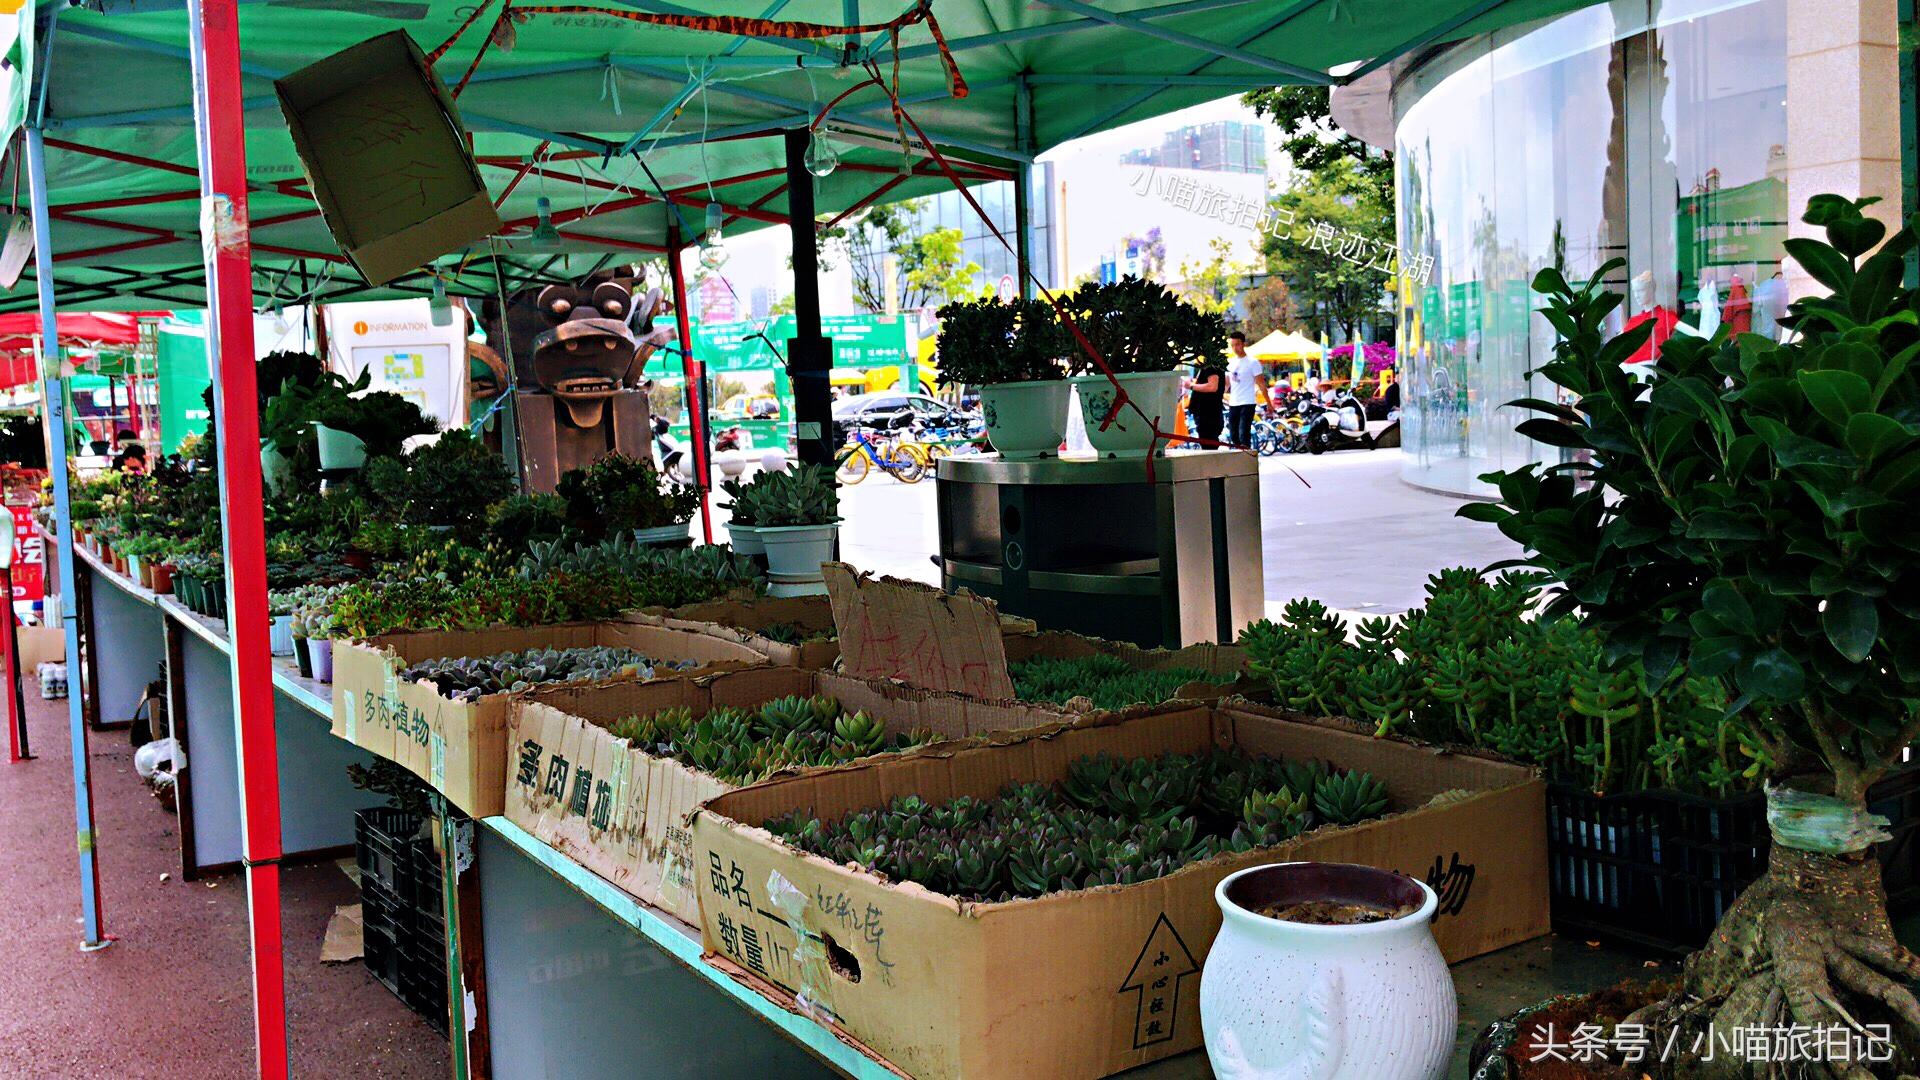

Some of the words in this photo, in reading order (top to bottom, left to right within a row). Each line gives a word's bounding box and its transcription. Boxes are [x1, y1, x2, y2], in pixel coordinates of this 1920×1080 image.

[369, 322, 428, 332] INFORMATION
[364, 688, 430, 748] 多肉植物
[709, 849, 754, 913] 品名
[718, 911, 770, 977] 数量
